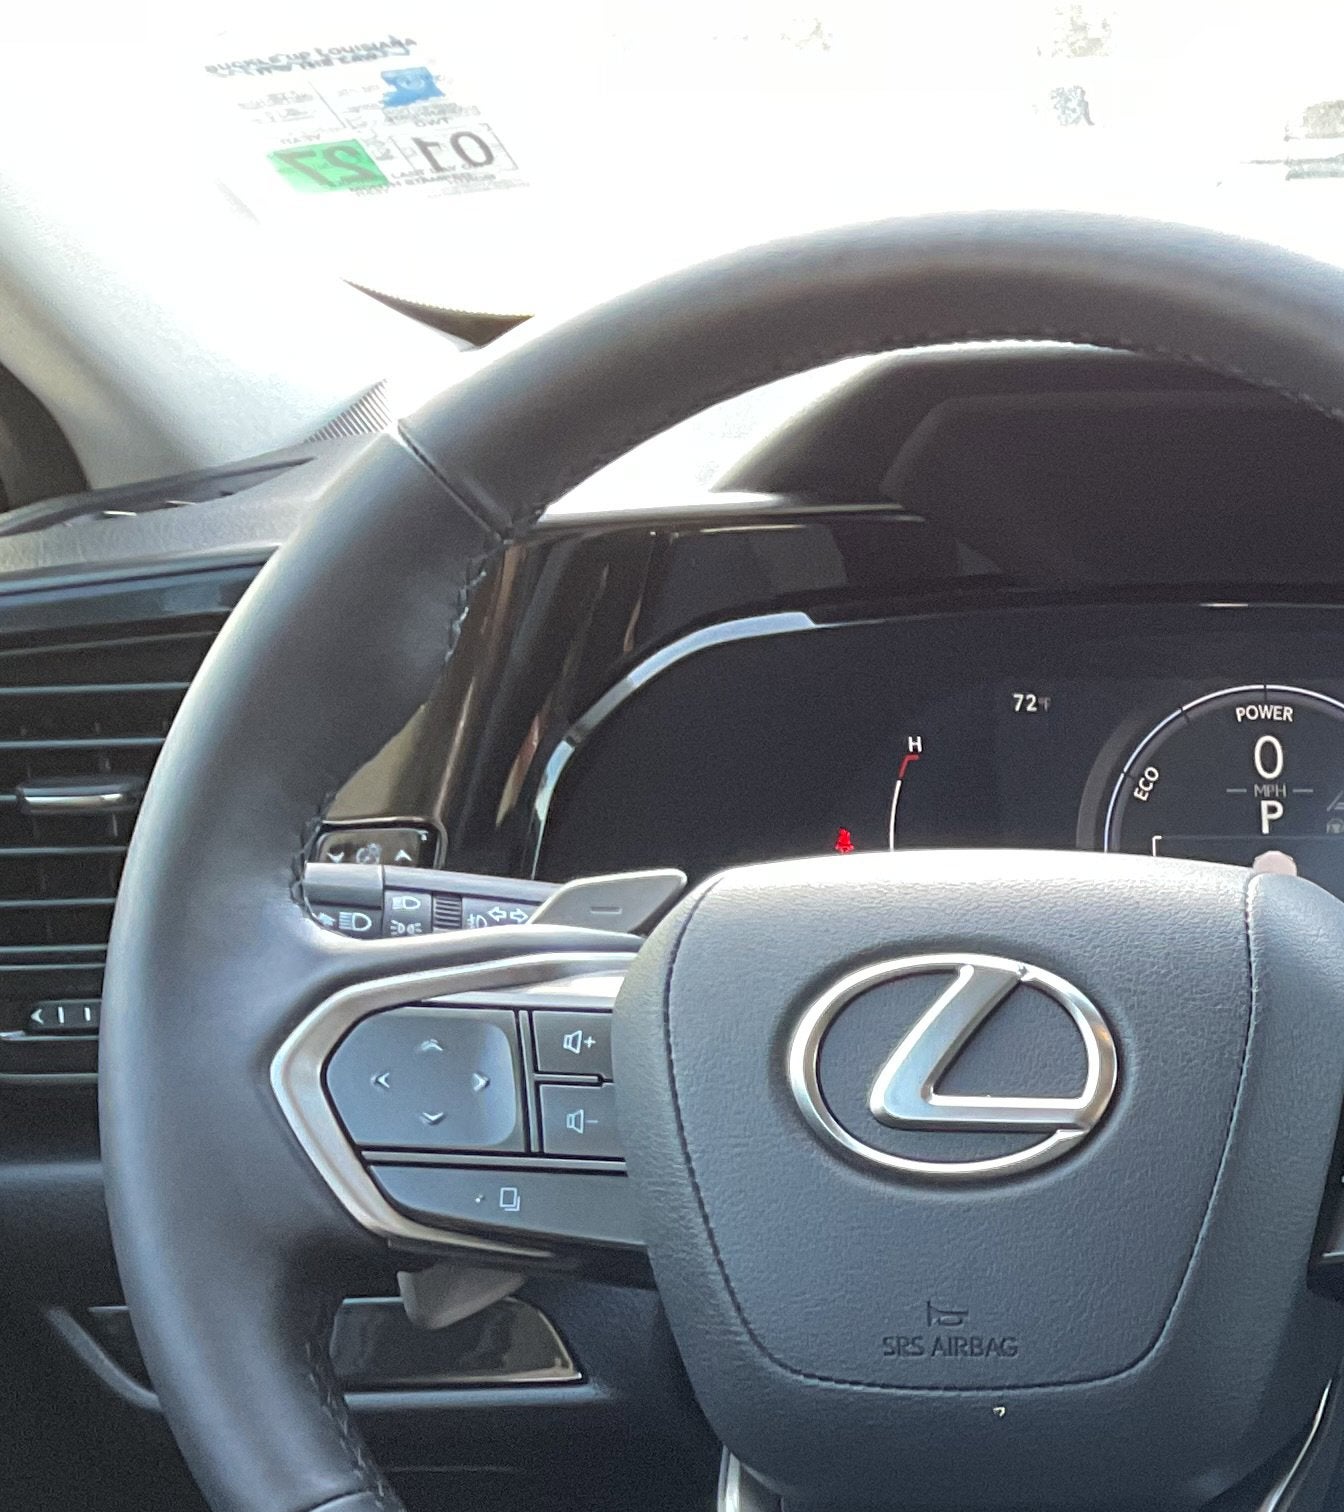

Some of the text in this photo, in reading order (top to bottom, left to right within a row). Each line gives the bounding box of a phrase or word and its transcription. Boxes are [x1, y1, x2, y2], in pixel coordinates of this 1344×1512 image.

[1235, 704, 1294, 722] POWER
[908, 736, 923, 753] H
[1254, 735, 1284, 780] 0
[1133, 765, 1160, 802] ECO
[1254, 784, 1287, 798] MPH
[1260, 801, 1284, 834] P
[882, 1335, 1019, 1358] SRS AIRBAG
